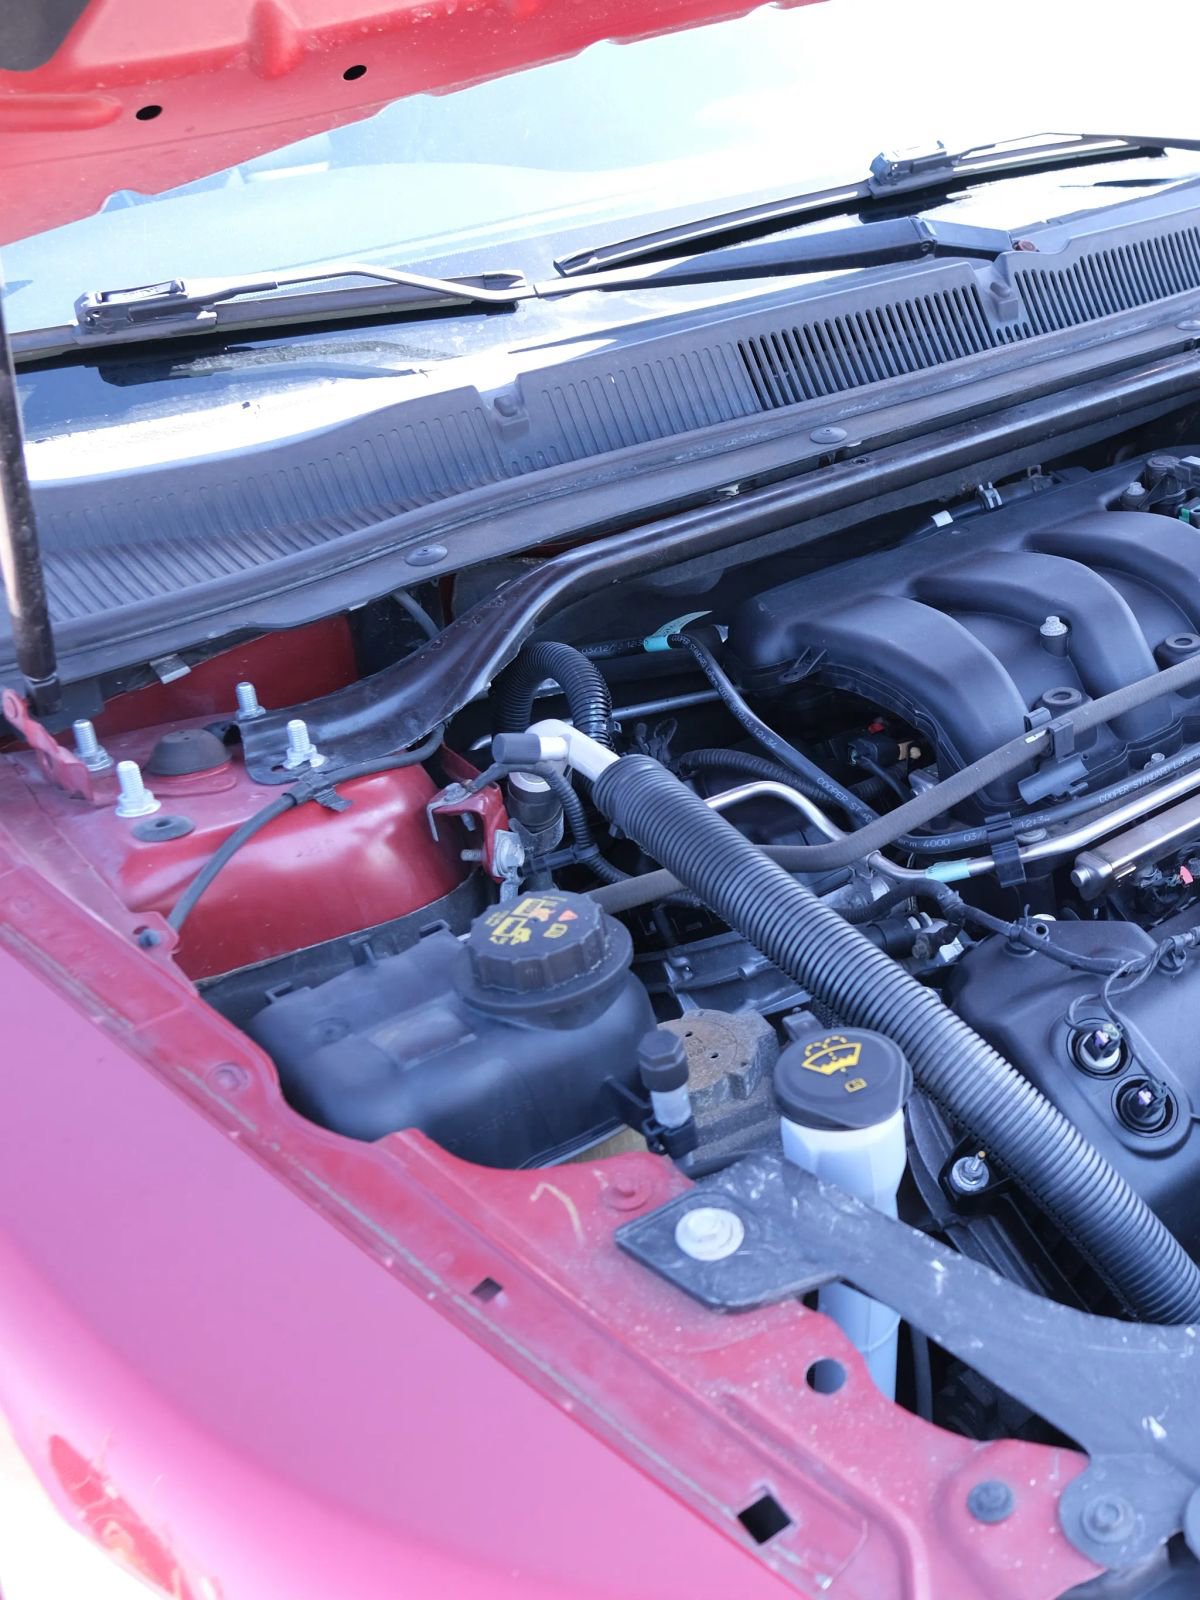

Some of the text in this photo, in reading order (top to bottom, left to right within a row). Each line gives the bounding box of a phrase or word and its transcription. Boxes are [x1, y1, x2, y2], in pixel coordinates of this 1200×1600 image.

[816, 777, 849, 802] COOPER
[1098, 784, 1130, 804] COOPER
[1133, 765, 1171, 789] STANDARD
[922, 838, 951, 848] 4000
